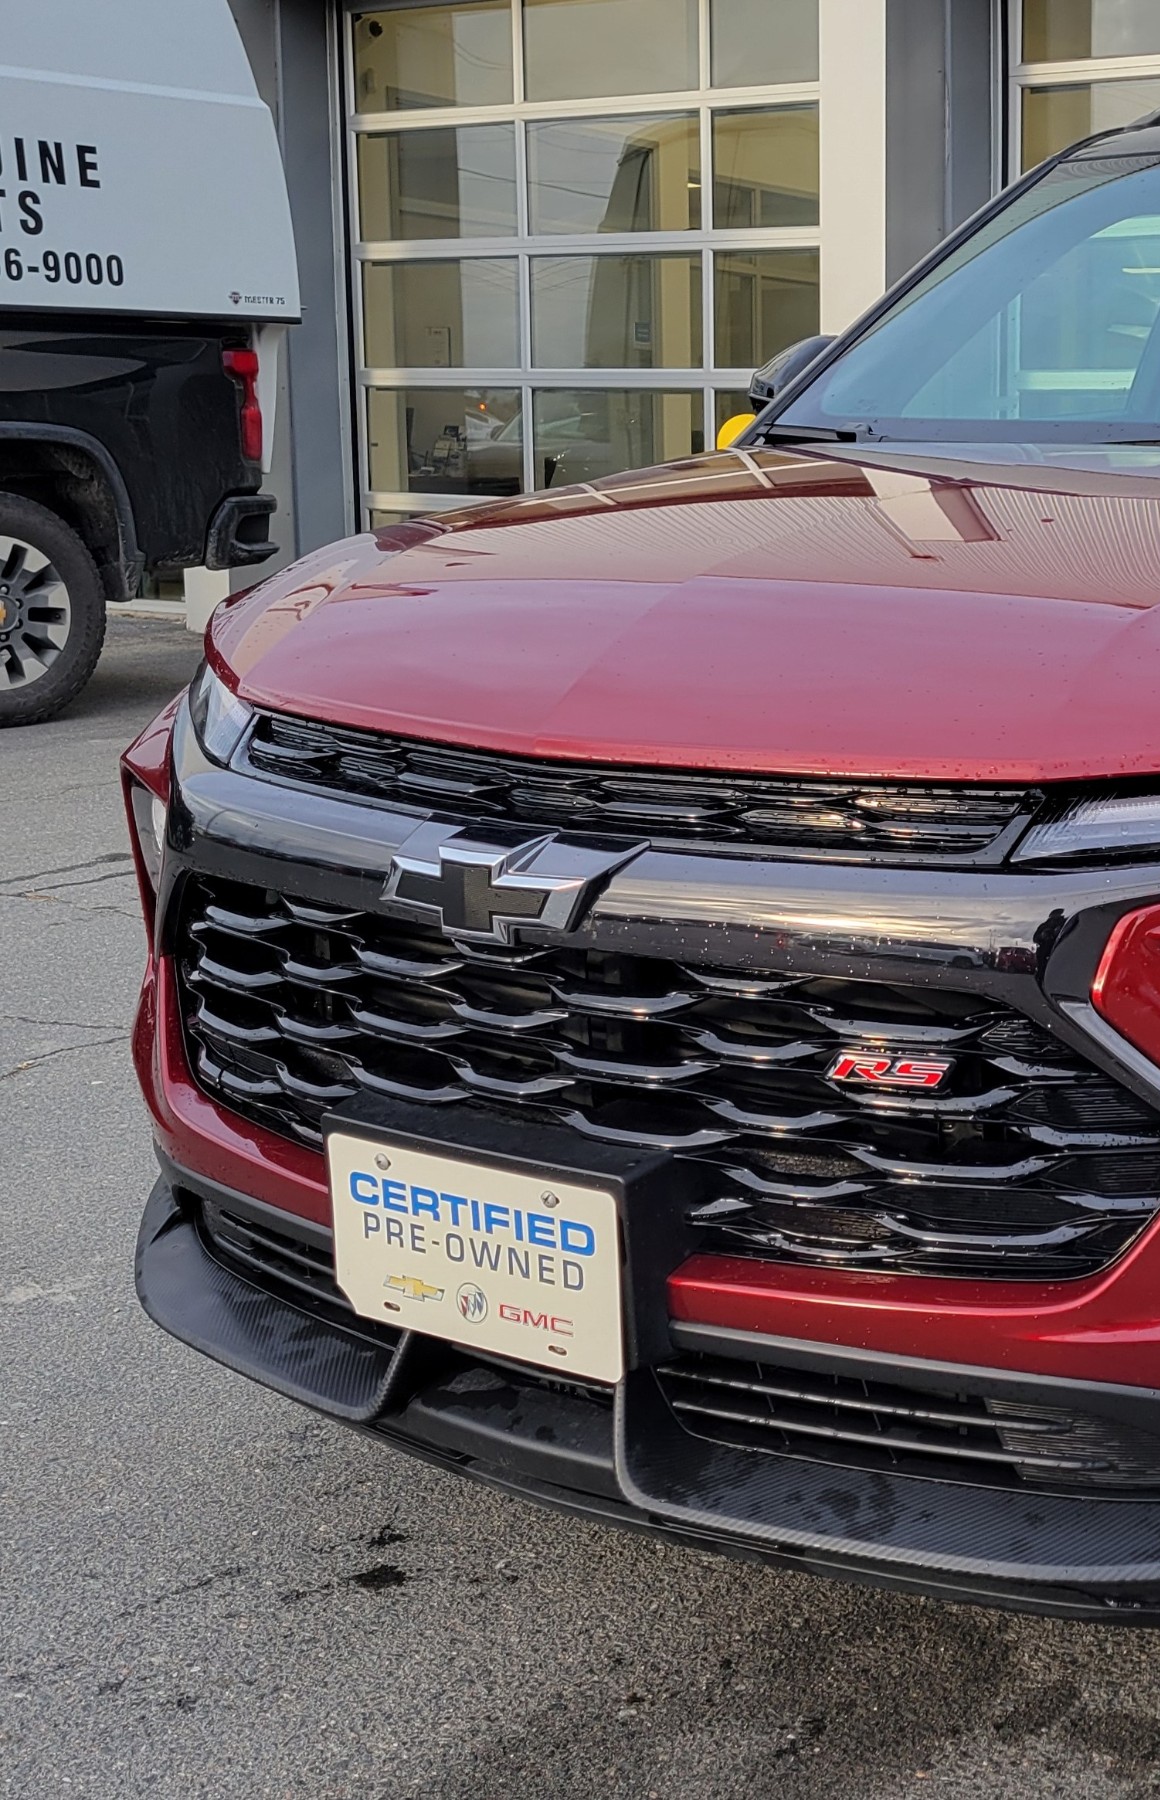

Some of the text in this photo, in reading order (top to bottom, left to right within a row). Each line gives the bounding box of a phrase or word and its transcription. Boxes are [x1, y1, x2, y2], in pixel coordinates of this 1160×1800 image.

[0, 137, 101, 189] INE
[0, 247, 124, 286] 6-9000
[825, 1053, 950, 1088] RS
[349, 1171, 596, 1257] CERTIFIED
[363, 1211, 585, 1292] PRE-OWNED
[499, 1303, 575, 1338] GMC
